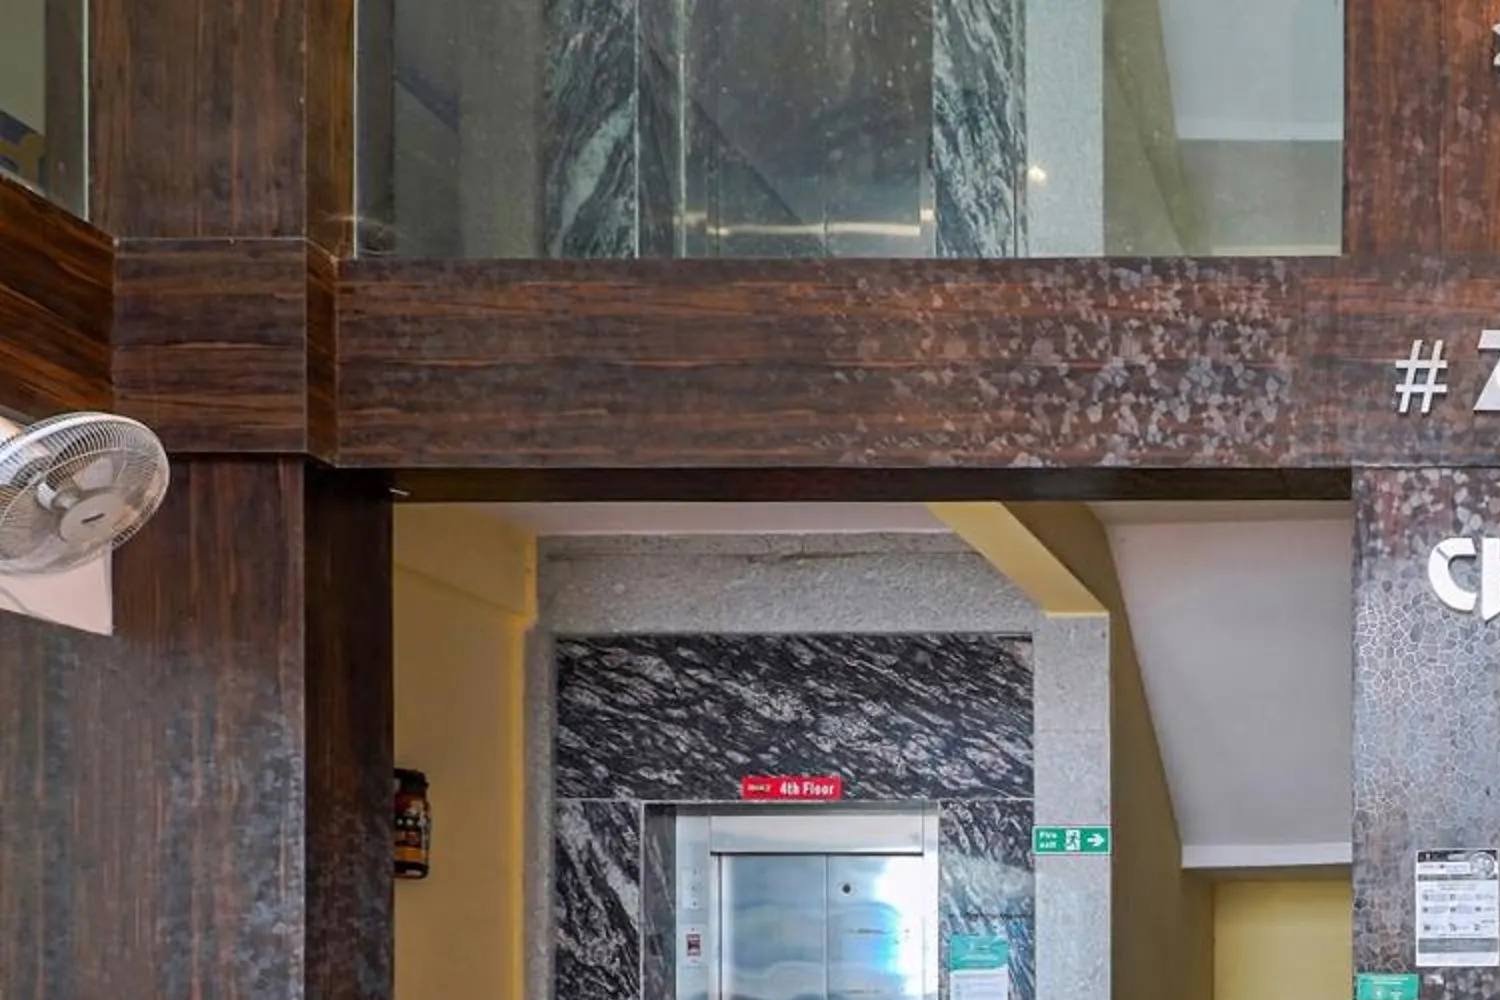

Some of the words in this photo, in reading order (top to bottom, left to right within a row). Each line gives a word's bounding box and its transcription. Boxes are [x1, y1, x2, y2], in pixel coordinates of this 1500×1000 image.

[1395, 339, 1448, 414] #
[780, 780, 800, 796] 4th
[802, 780, 835, 796] Floor
